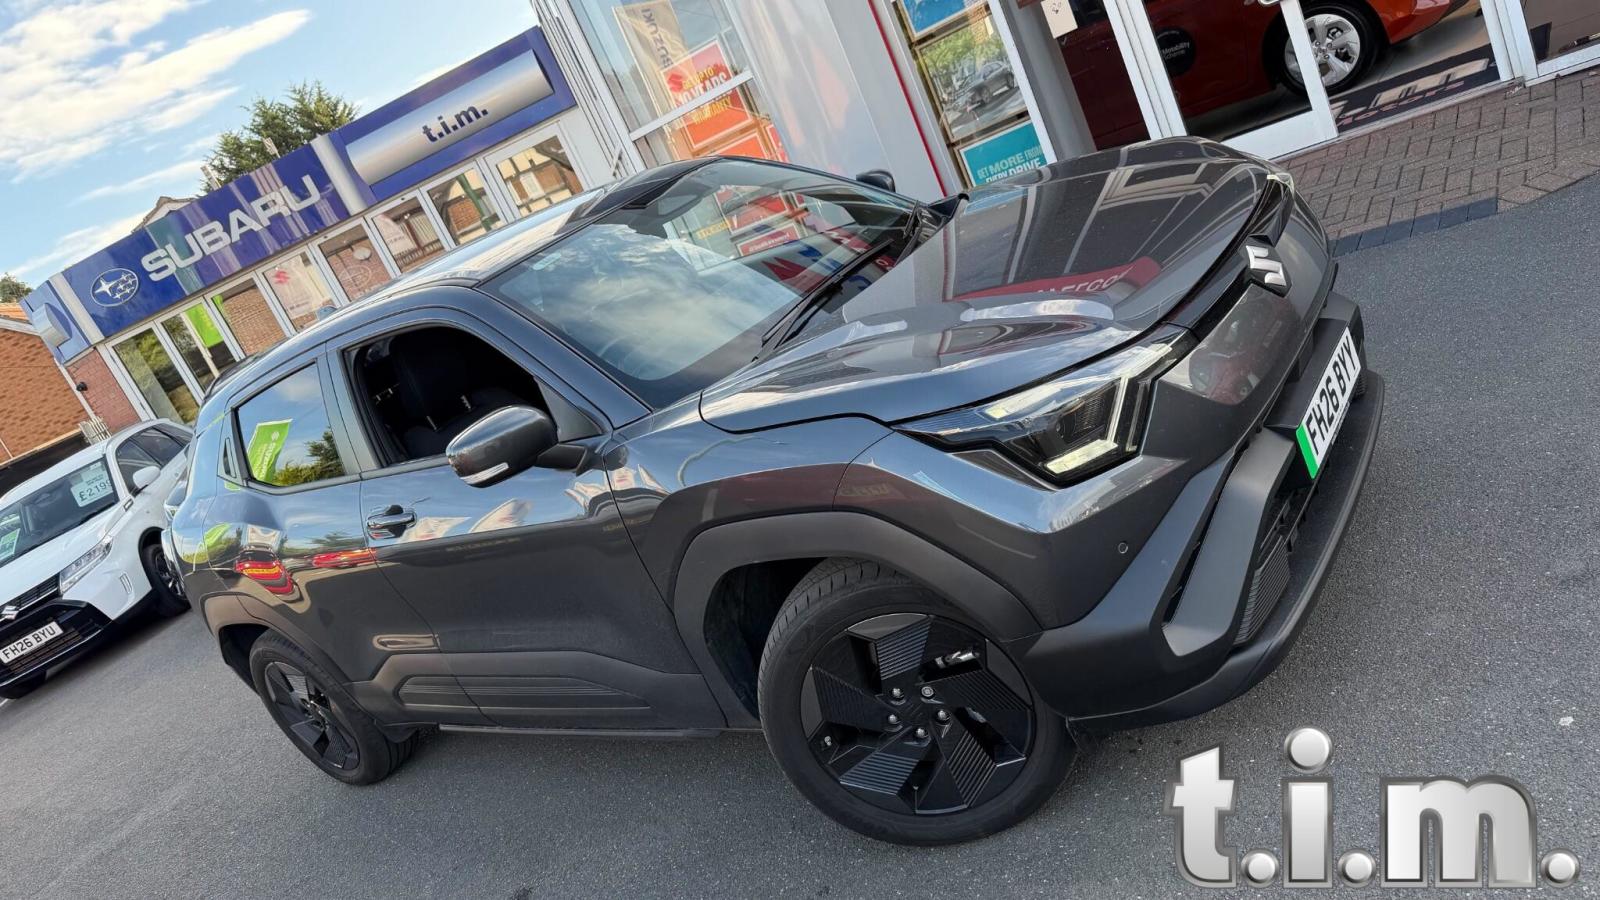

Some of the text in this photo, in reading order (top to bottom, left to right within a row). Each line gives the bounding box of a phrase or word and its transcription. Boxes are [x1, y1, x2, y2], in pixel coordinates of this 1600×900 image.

[641, 9, 674, 68] SUZUKI
[422, 106, 489, 142] t.i.m.
[988, 153, 1026, 174] MORE
[141, 174, 321, 282] SUBARU
[1306, 375, 1340, 456] FH26
[1332, 335, 1356, 397] BYY
[2, 625, 56, 659] FH26 BYU
